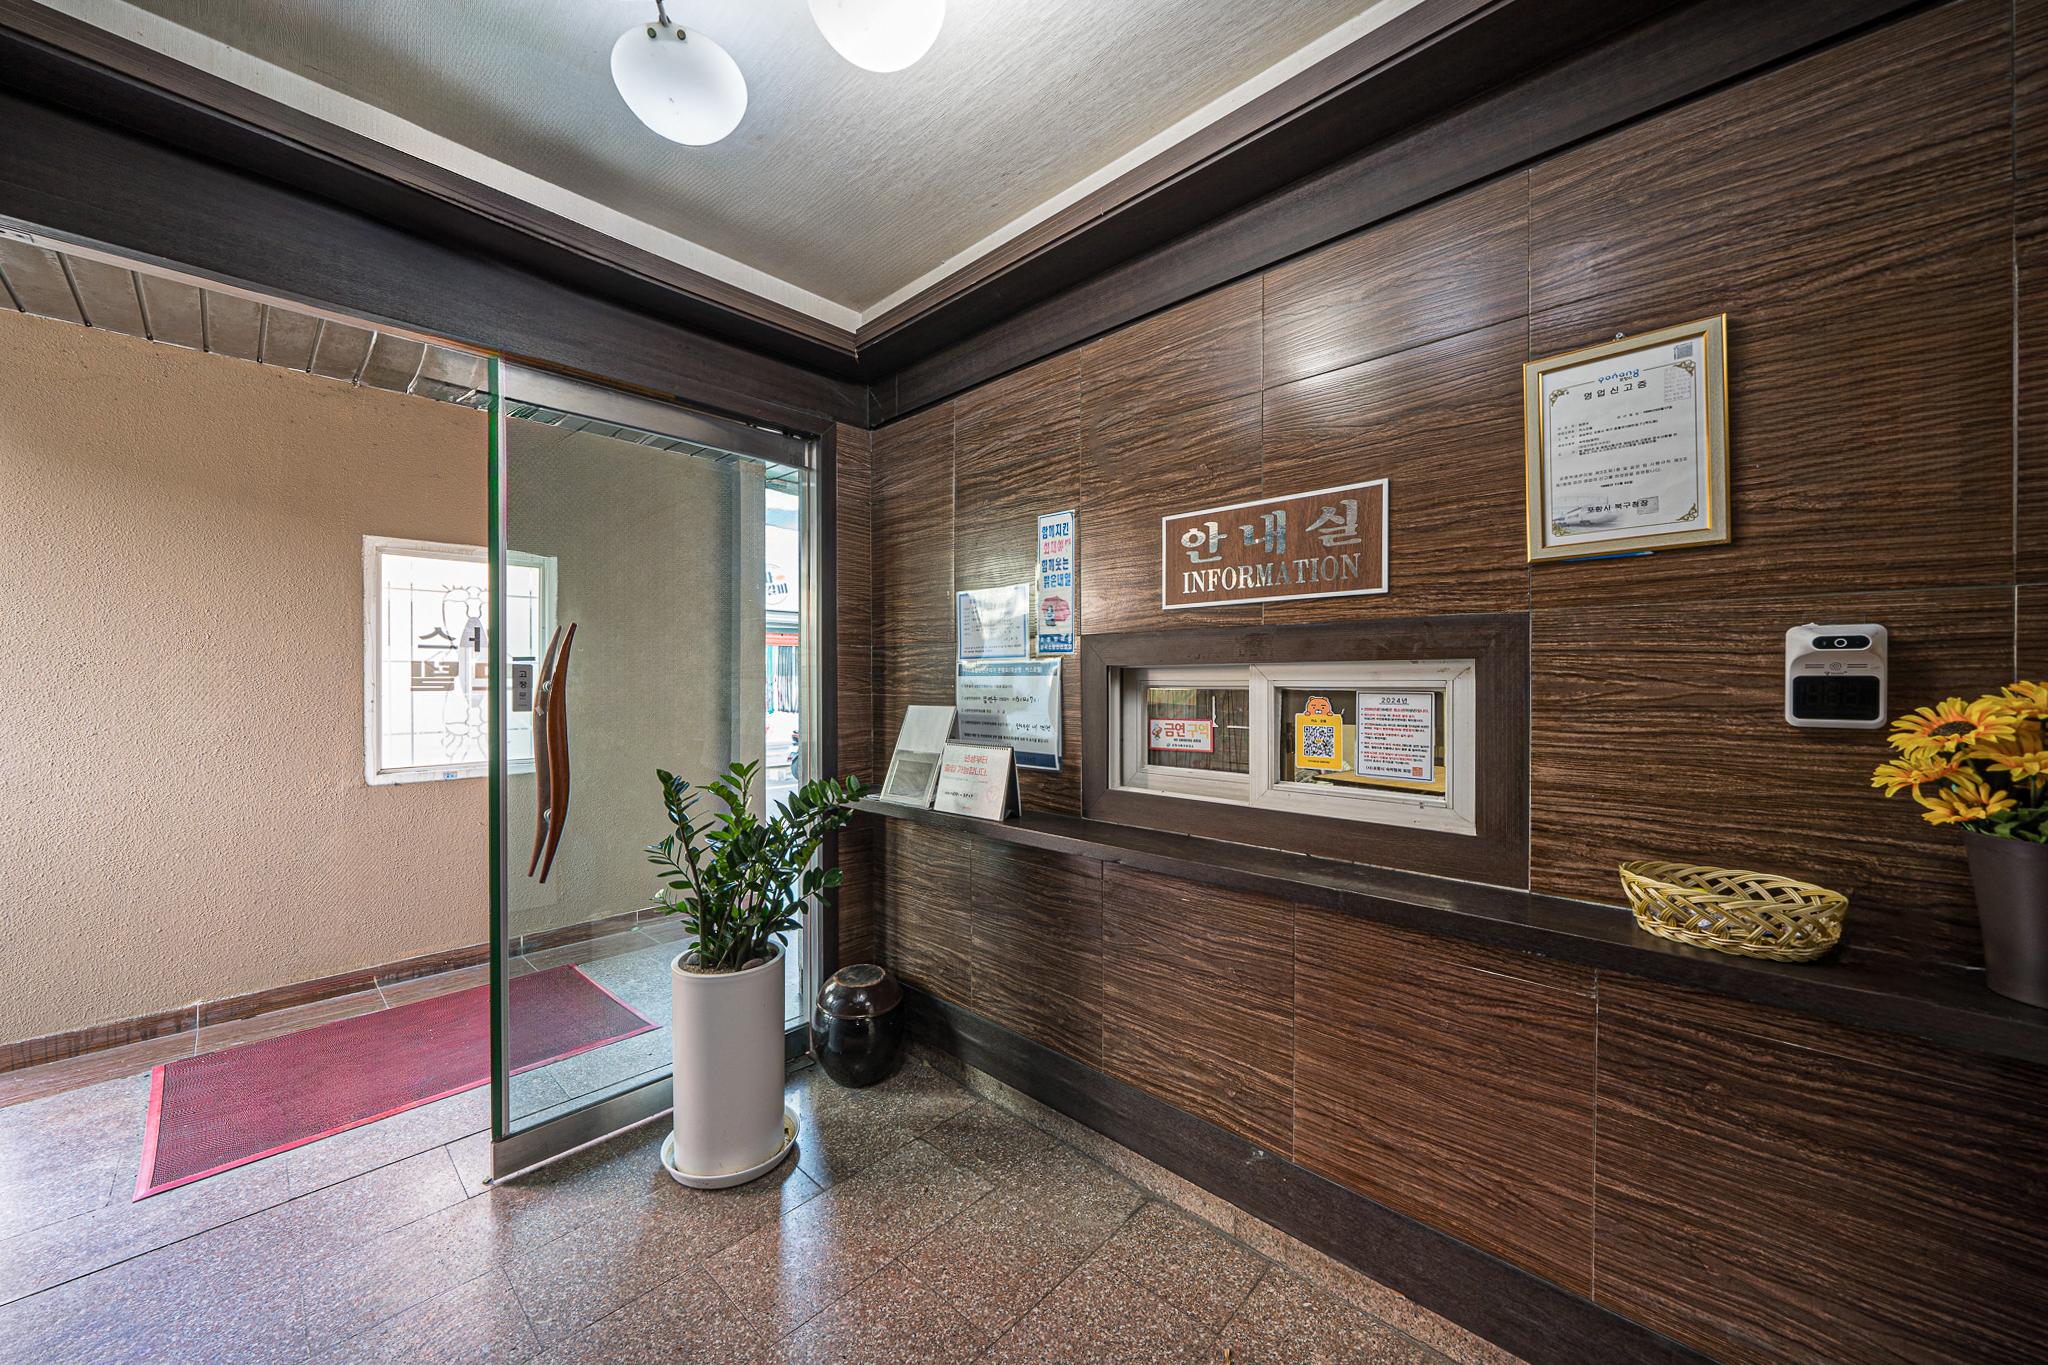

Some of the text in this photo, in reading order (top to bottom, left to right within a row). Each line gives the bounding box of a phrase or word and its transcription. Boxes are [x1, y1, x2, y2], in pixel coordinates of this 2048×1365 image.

[1180, 499, 1362, 564] 안내실
[1182, 552, 1361, 594] INFORMATION
[1164, 722, 1209, 738] 금연구역
